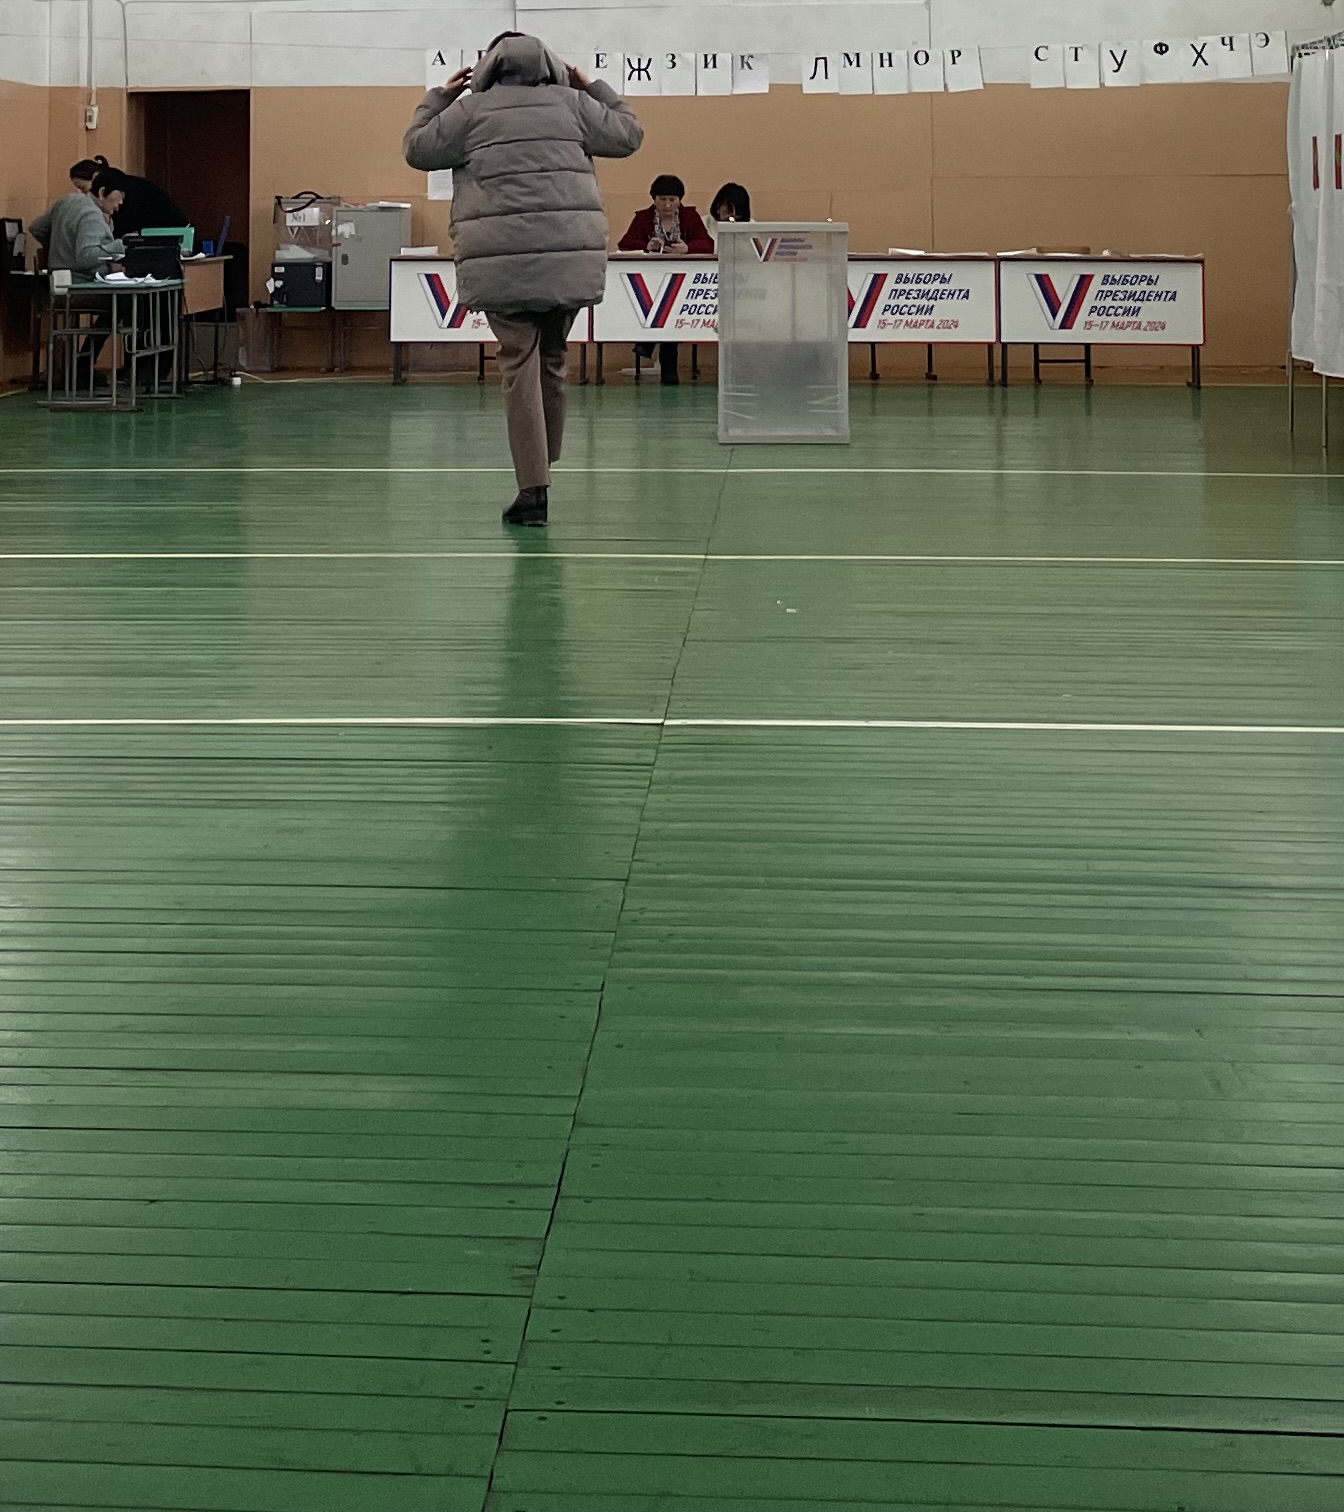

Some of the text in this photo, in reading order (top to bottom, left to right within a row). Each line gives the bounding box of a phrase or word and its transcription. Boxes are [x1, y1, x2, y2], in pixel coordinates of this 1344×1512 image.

[894, 273, 953, 285] ВЫБОРЫ
[1101, 274, 1160, 286] ВЫБОРЫ
[888, 289, 970, 301] ПРЕЗИДЕНТА
[1095, 290, 1177, 303] ПРЕЗИДЕНТА
[882, 304, 935, 316] РОССИИ
[1088, 306, 1142, 317] РОССИИ
[903, 319, 935, 329] МАРТА
[936, 319, 959, 329] 2024
[1109, 320, 1142, 331] МАРТА
[1143, 320, 1166, 332] 2024
